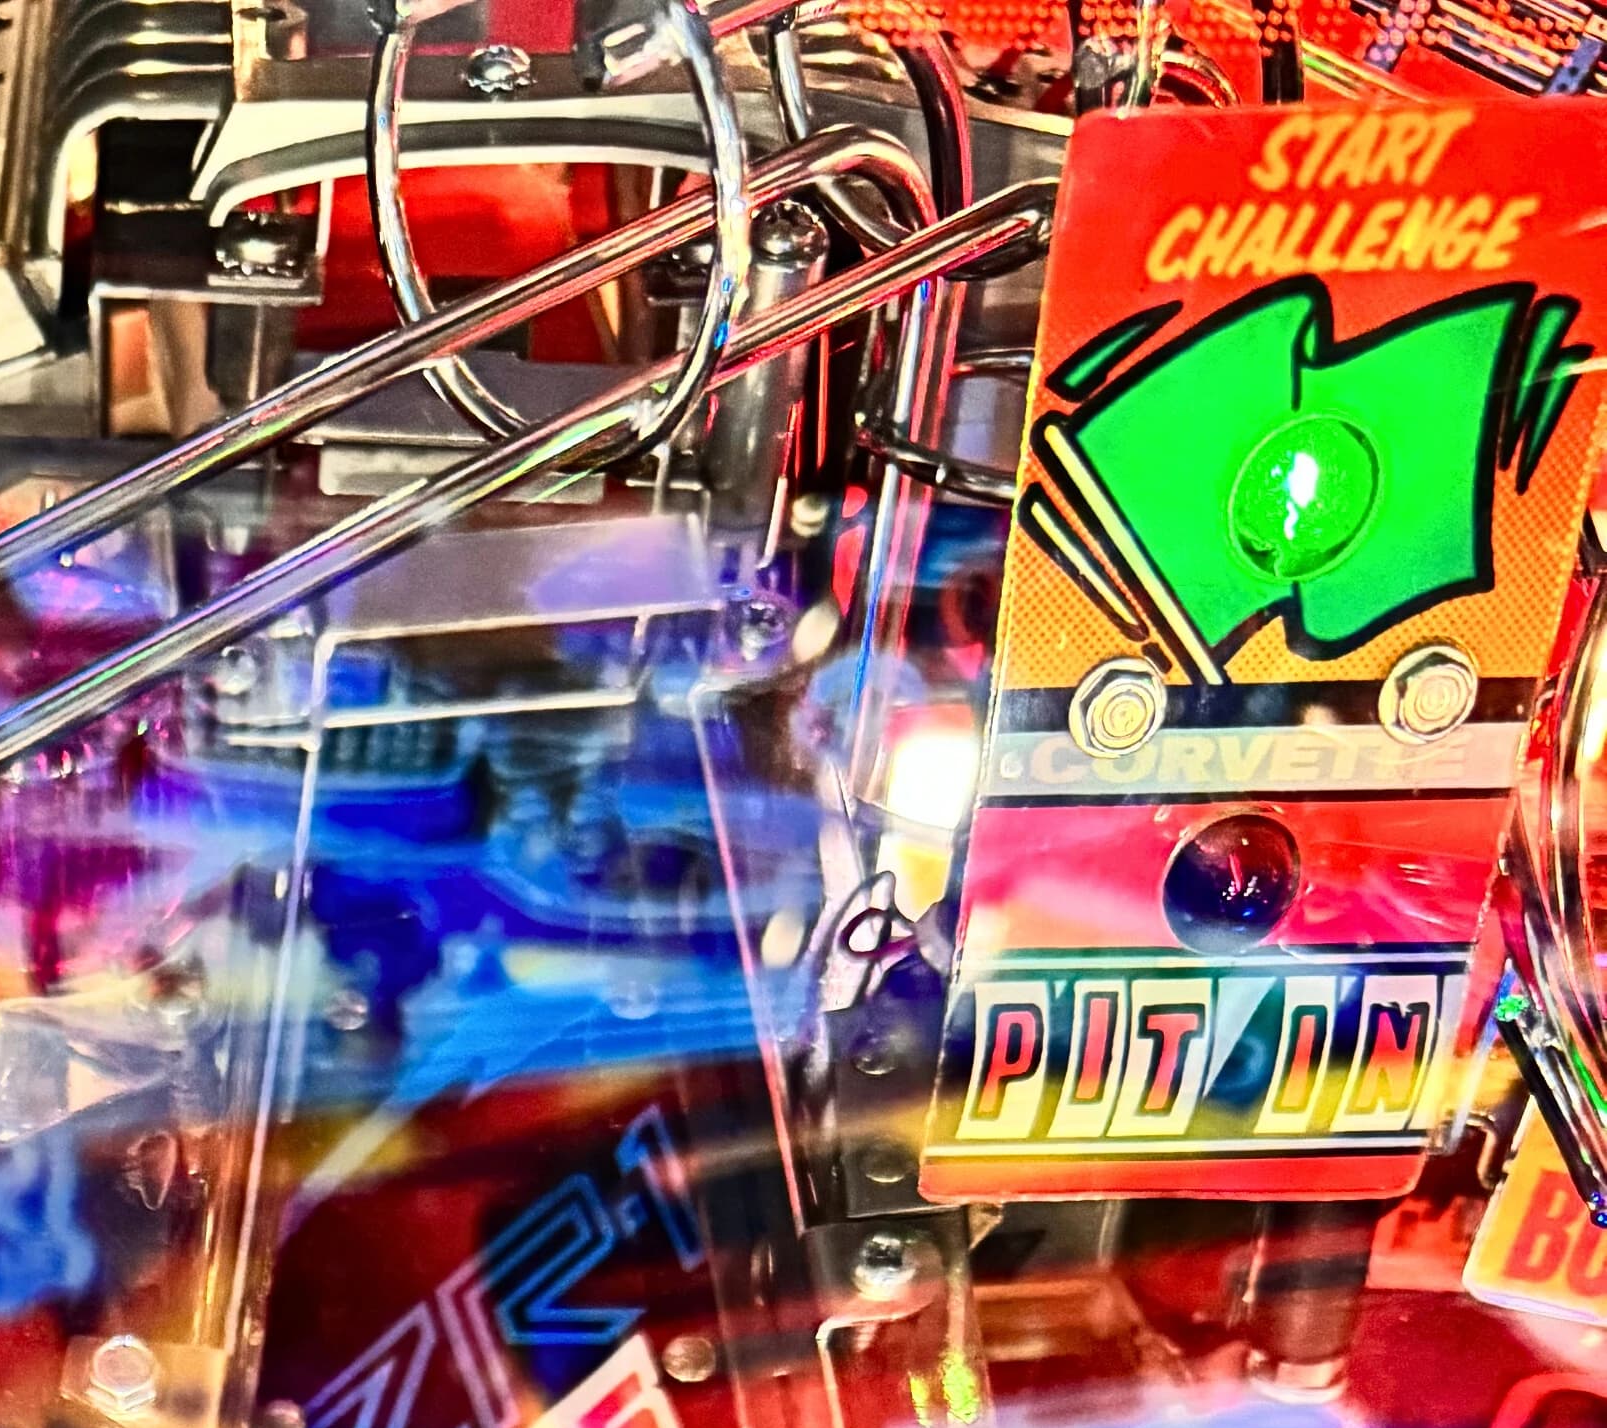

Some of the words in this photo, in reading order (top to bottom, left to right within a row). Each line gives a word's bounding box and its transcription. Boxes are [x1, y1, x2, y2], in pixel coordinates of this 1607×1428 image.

[1249, 108, 1475, 193] START
[1146, 195, 1540, 284] CHALLENGE
[971, 988, 1202, 1120] PIT
[1274, 1000, 1434, 1117] IN
